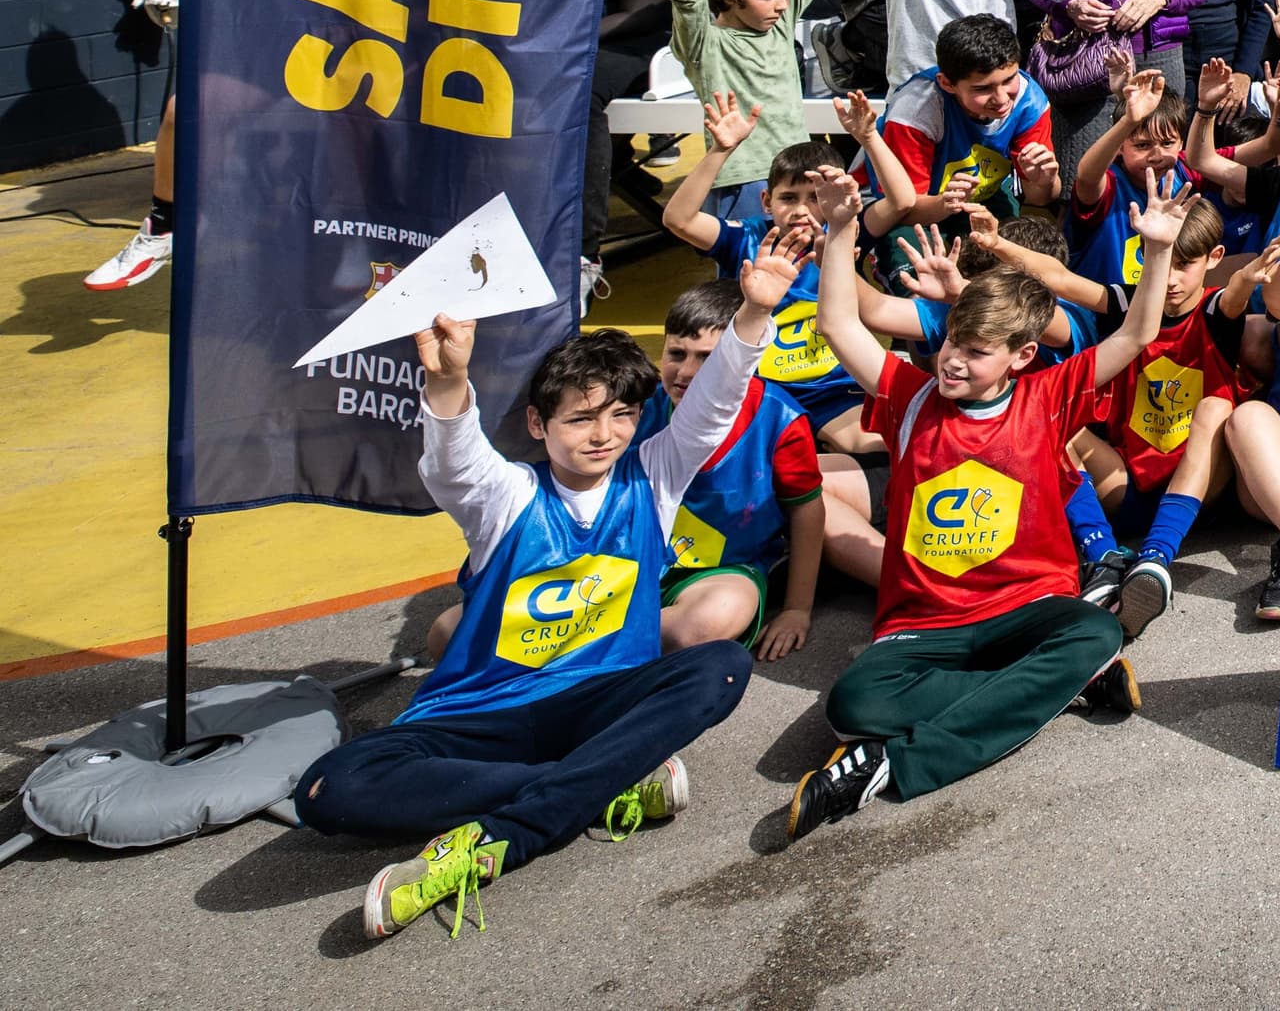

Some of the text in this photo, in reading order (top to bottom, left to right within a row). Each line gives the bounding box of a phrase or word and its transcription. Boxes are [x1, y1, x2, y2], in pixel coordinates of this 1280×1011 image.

[314, 219, 397, 242] PARTNER
[774, 344, 828, 367] CRUYF
[1143, 409, 1193, 426] CRUYFF
[922, 529, 1000, 546] CRUYFF
[925, 547, 993, 557] FOUNDATION
[521, 609, 607, 644] CRUYFF
